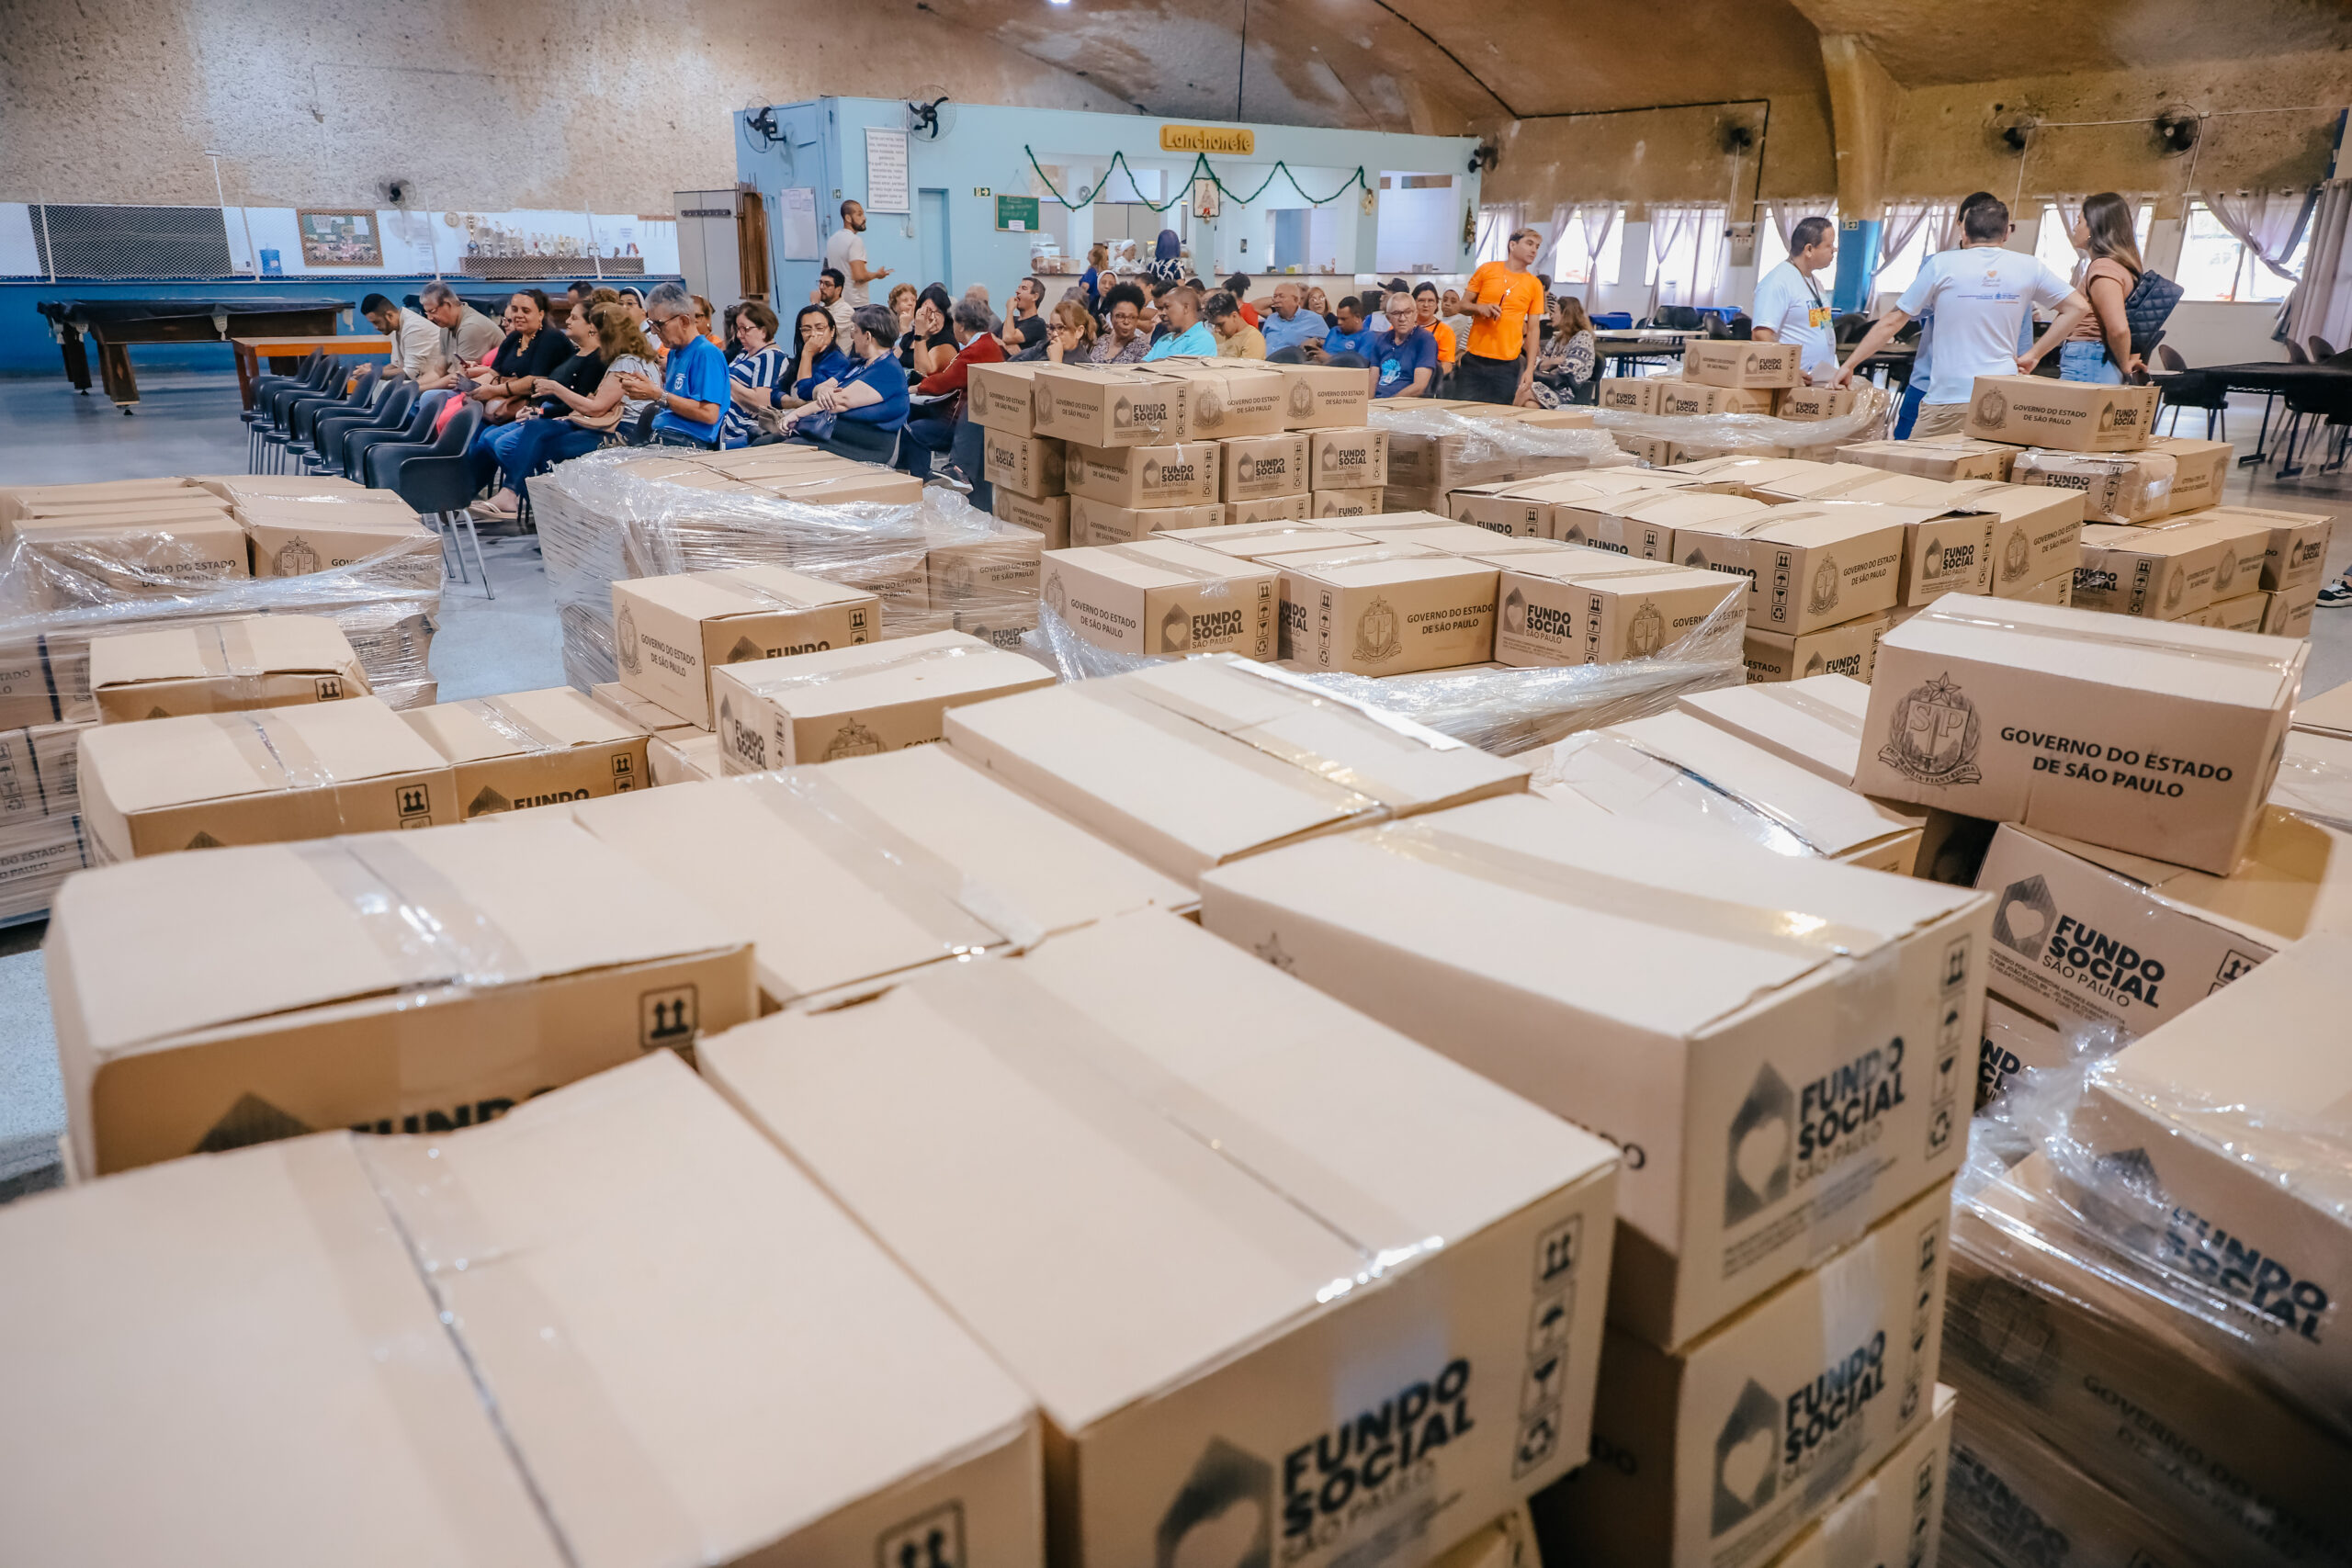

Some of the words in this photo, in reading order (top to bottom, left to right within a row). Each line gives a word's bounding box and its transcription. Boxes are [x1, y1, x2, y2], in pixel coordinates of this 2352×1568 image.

[1162, 128, 1250, 152] Lanchonete
[1056, 398, 1075, 408] GOVERNO
[1081, 402, 1099, 412] ESTADO
[1134, 403, 1166, 413] FUNDO
[1227, 397, 1252, 406] GOVERNO
[1253, 396, 1261, 404] DO
[1261, 395, 1280, 403] ESTADO
[1245, 405, 1255, 413] SÃO
[1256, 404, 1272, 412] PAULO
[1333, 397, 1342, 405] SÃO
[1077, 411, 1091, 420] PAULO
[1134, 412, 1168, 422] SOCIAL
[1796, 407, 1819, 415] SOCIAL
[2013, 403, 2045, 413] GOVERNO
[2059, 409, 2087, 418] ESTADO
[2038, 413, 2048, 423] SÃO
[2049, 417, 2071, 425] PAULO
[2115, 409, 2138, 417] FUNDO
[2114, 416, 2136, 425] SOCIAL
[1339, 448, 1365, 458] FUNDO
[1339, 457, 1366, 466] SOCIAL
[1161, 465, 1193, 475] FUNDO
[1256, 458, 1284, 468] FUNDO
[1256, 466, 1285, 476] SOCIAL
[1161, 472, 1195, 482] SOCIAL
[2047, 473, 2090, 486] FUNDO
[1012, 505, 1029, 516] GOVERNO
[1036, 512, 1051, 524] ESTADO
[1339, 506, 1363, 516] FUNDO
[1091, 521, 1108, 533] GOVERNO
[1108, 525, 1114, 534] DO
[1114, 526, 1131, 537] ESTADO
[2034, 531, 2057, 546] GOVERNO
[2058, 527, 2065, 538] DO
[2065, 520, 2081, 534] ESTADO
[1588, 538, 1628, 555] FUNDO
[1943, 544, 1974, 559] FUNDO
[2041, 544, 2049, 553] DE
[2050, 538, 2059, 550] SÃO
[2060, 534, 2074, 547] PAULO
[1022, 559, 1041, 569] ESTAD
[1844, 561, 1867, 577] GOVERNO
[1868, 558, 1877, 570] DO
[1878, 553, 1897, 568] ESTADO
[1942, 555, 1973, 570] SOCIAL
[992, 573, 1001, 581] DE
[1002, 570, 1014, 581] SÃO
[1014, 569, 1034, 579] PAULO
[1851, 577, 1860, 586] DE
[1860, 572, 1869, 585] SÃO
[1870, 568, 1886, 581] PAULO
[1071, 598, 1099, 616] GOVERNO
[1100, 608, 1109, 620] DO
[1110, 611, 1136, 628] ESTADO
[1279, 598, 1307, 619] UNDO
[1407, 609, 1448, 624] GOVERNO
[1450, 607, 1462, 618] DO
[1463, 603, 1494, 615] ESTADO
[1527, 604, 1572, 625] FUNDO
[1080, 615, 1089, 626] DE
[1089, 616, 1102, 632] SÃO
[1102, 622, 1124, 638] PAULO
[1193, 609, 1242, 629] FUNDO
[1279, 613, 1308, 632] OCIAL
[1421, 625, 1433, 635] DE
[1434, 621, 1451, 634] SÃO
[1452, 618, 1479, 630] PAULO
[1526, 615, 1573, 638] SOCIAL
[1193, 622, 1244, 640] SOCIAL
[1525, 627, 1539, 639] SÃO
[1540, 632, 1562, 645] PAULO
[640, 633, 665, 654] GOVERNO
[665, 645, 674, 657] DO
[674, 647, 696, 667] ESTADO
[1192, 637, 1208, 649] SÃO
[1209, 635, 1233, 647] PAULO
[650, 652, 659, 665] DE
[658, 655, 669, 671] SÃO
[669, 660, 687, 678] PAULO
[1826, 653, 1860, 672] FUNDO
[735, 718, 765, 753] FUNDO
[736, 735, 768, 772] SOCIAL
[2000, 726, 2102, 759] GOVERNO
[2106, 746, 2140, 766] DO
[2144, 753, 2233, 783] ESTADO
[2032, 755, 2061, 774] DE
[2064, 761, 2108, 784] SÃO
[2111, 771, 2185, 798] PAULO
[2054, 914, 2165, 984] FUNDO
[2042, 953, 2075, 979] SÃO
[2077, 973, 2131, 1009] PAULO
[2048, 935, 2160, 1010] SOCIAL
[1799, 1034, 1906, 1123] FUNDO
[1797, 1071, 1906, 1161] SOCIAL
[1785, 1329, 1887, 1431] FUNDO
[1783, 1362, 1886, 1466] SOCIAL
[1283, 1357, 1472, 1497] FUNDO
[1283, 1395, 1476, 1538] SOCIAL
